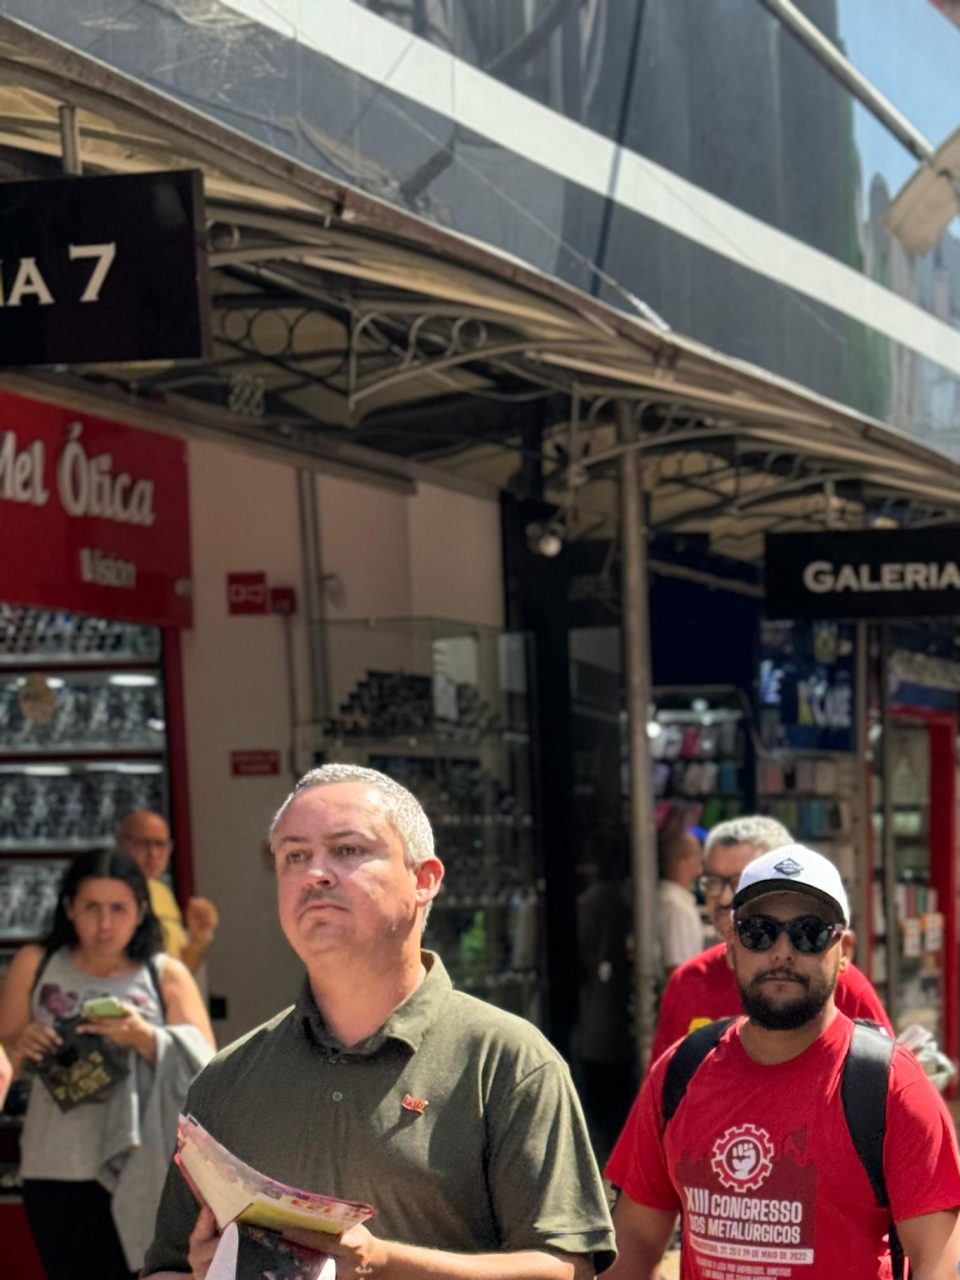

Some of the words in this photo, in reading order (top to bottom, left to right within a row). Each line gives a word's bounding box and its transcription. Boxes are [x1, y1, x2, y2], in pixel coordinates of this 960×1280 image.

[68, 241, 116, 302] 7
[58, 421, 155, 527] Ótica
[711, 1194, 803, 1224] CONGRESSO
[708, 1218, 801, 1244] METALÚRGICOS
[789, 1251, 808, 1262] 2022
